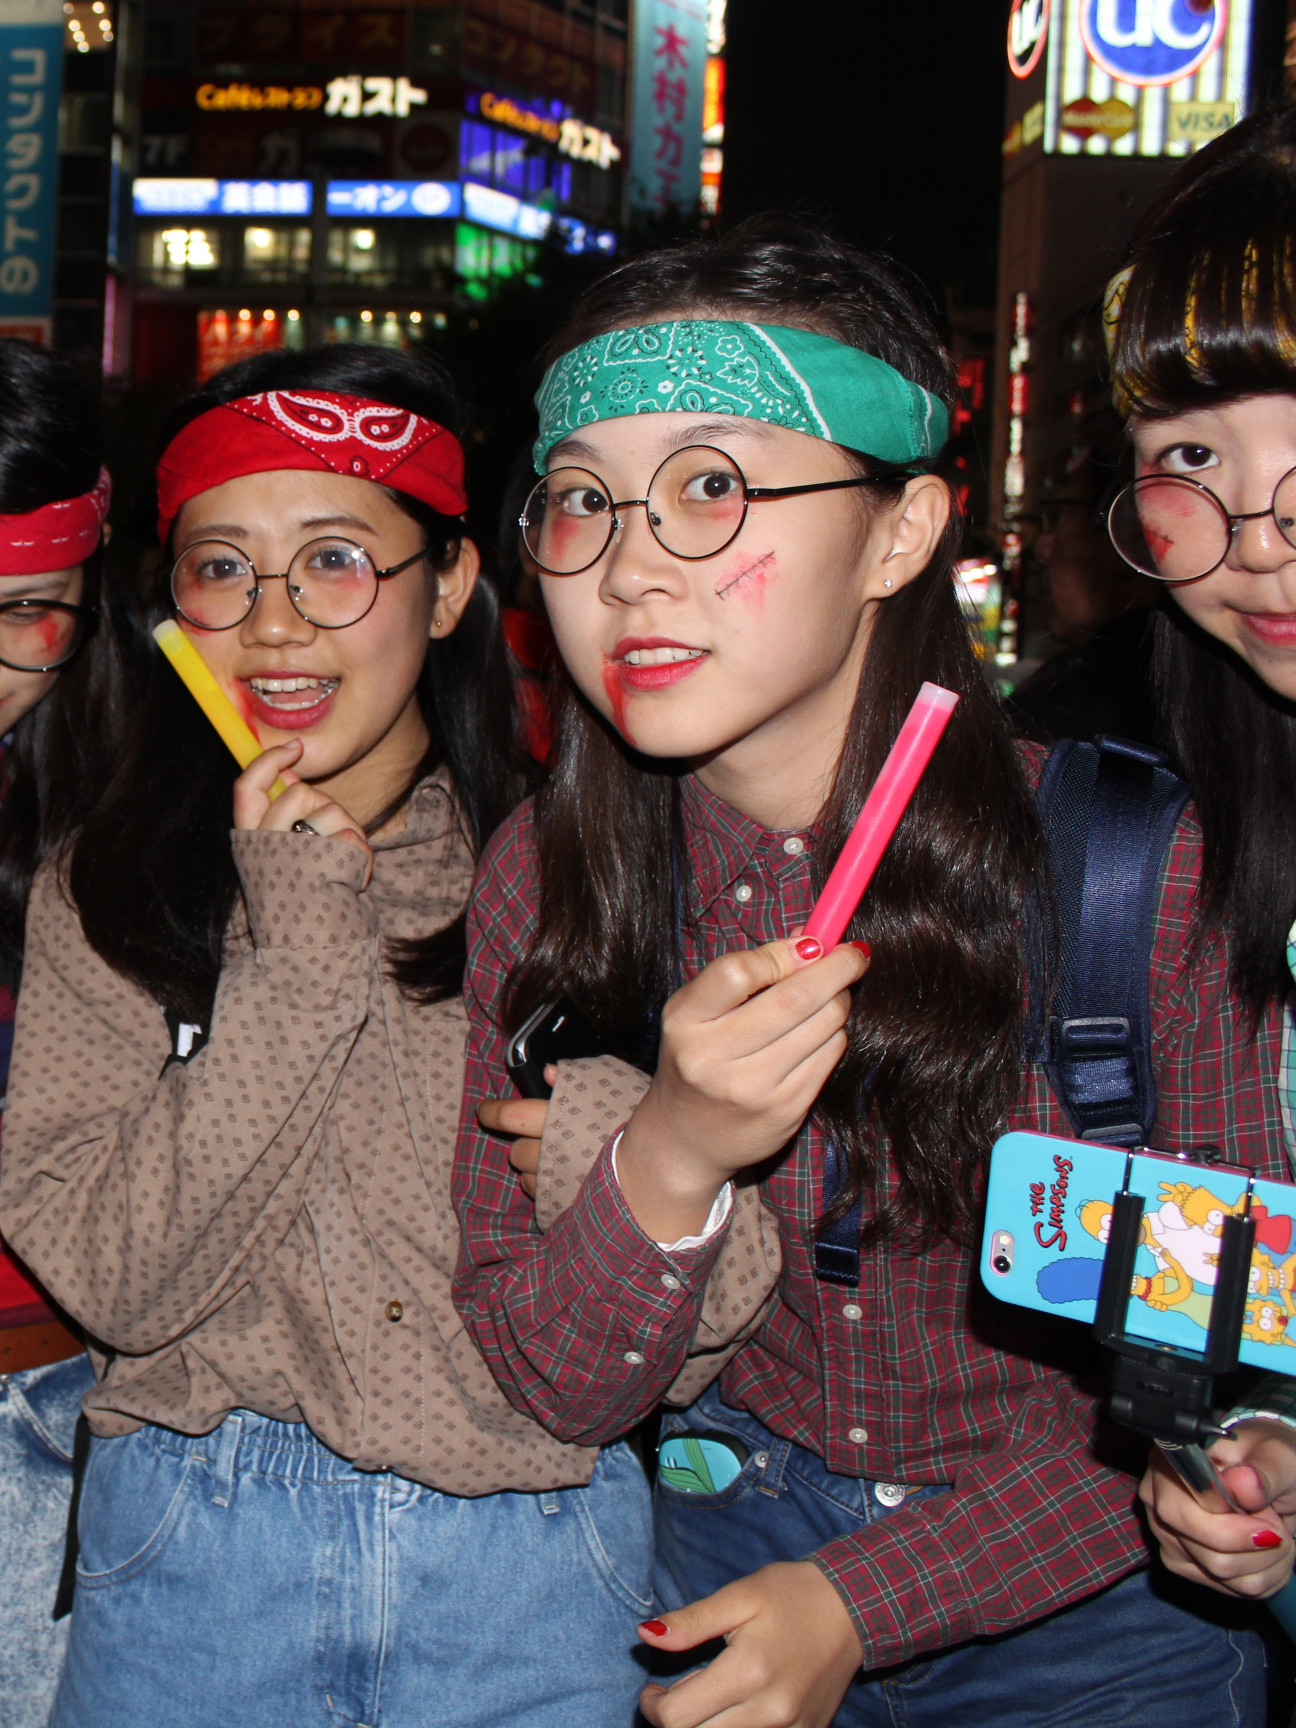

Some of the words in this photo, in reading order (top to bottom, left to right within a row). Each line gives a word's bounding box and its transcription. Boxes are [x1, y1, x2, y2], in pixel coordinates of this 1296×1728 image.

[324, 75, 428, 118] ガスト
[652, 23, 690, 216] 木村カエ
[1176, 112, 1235, 131] VISA
